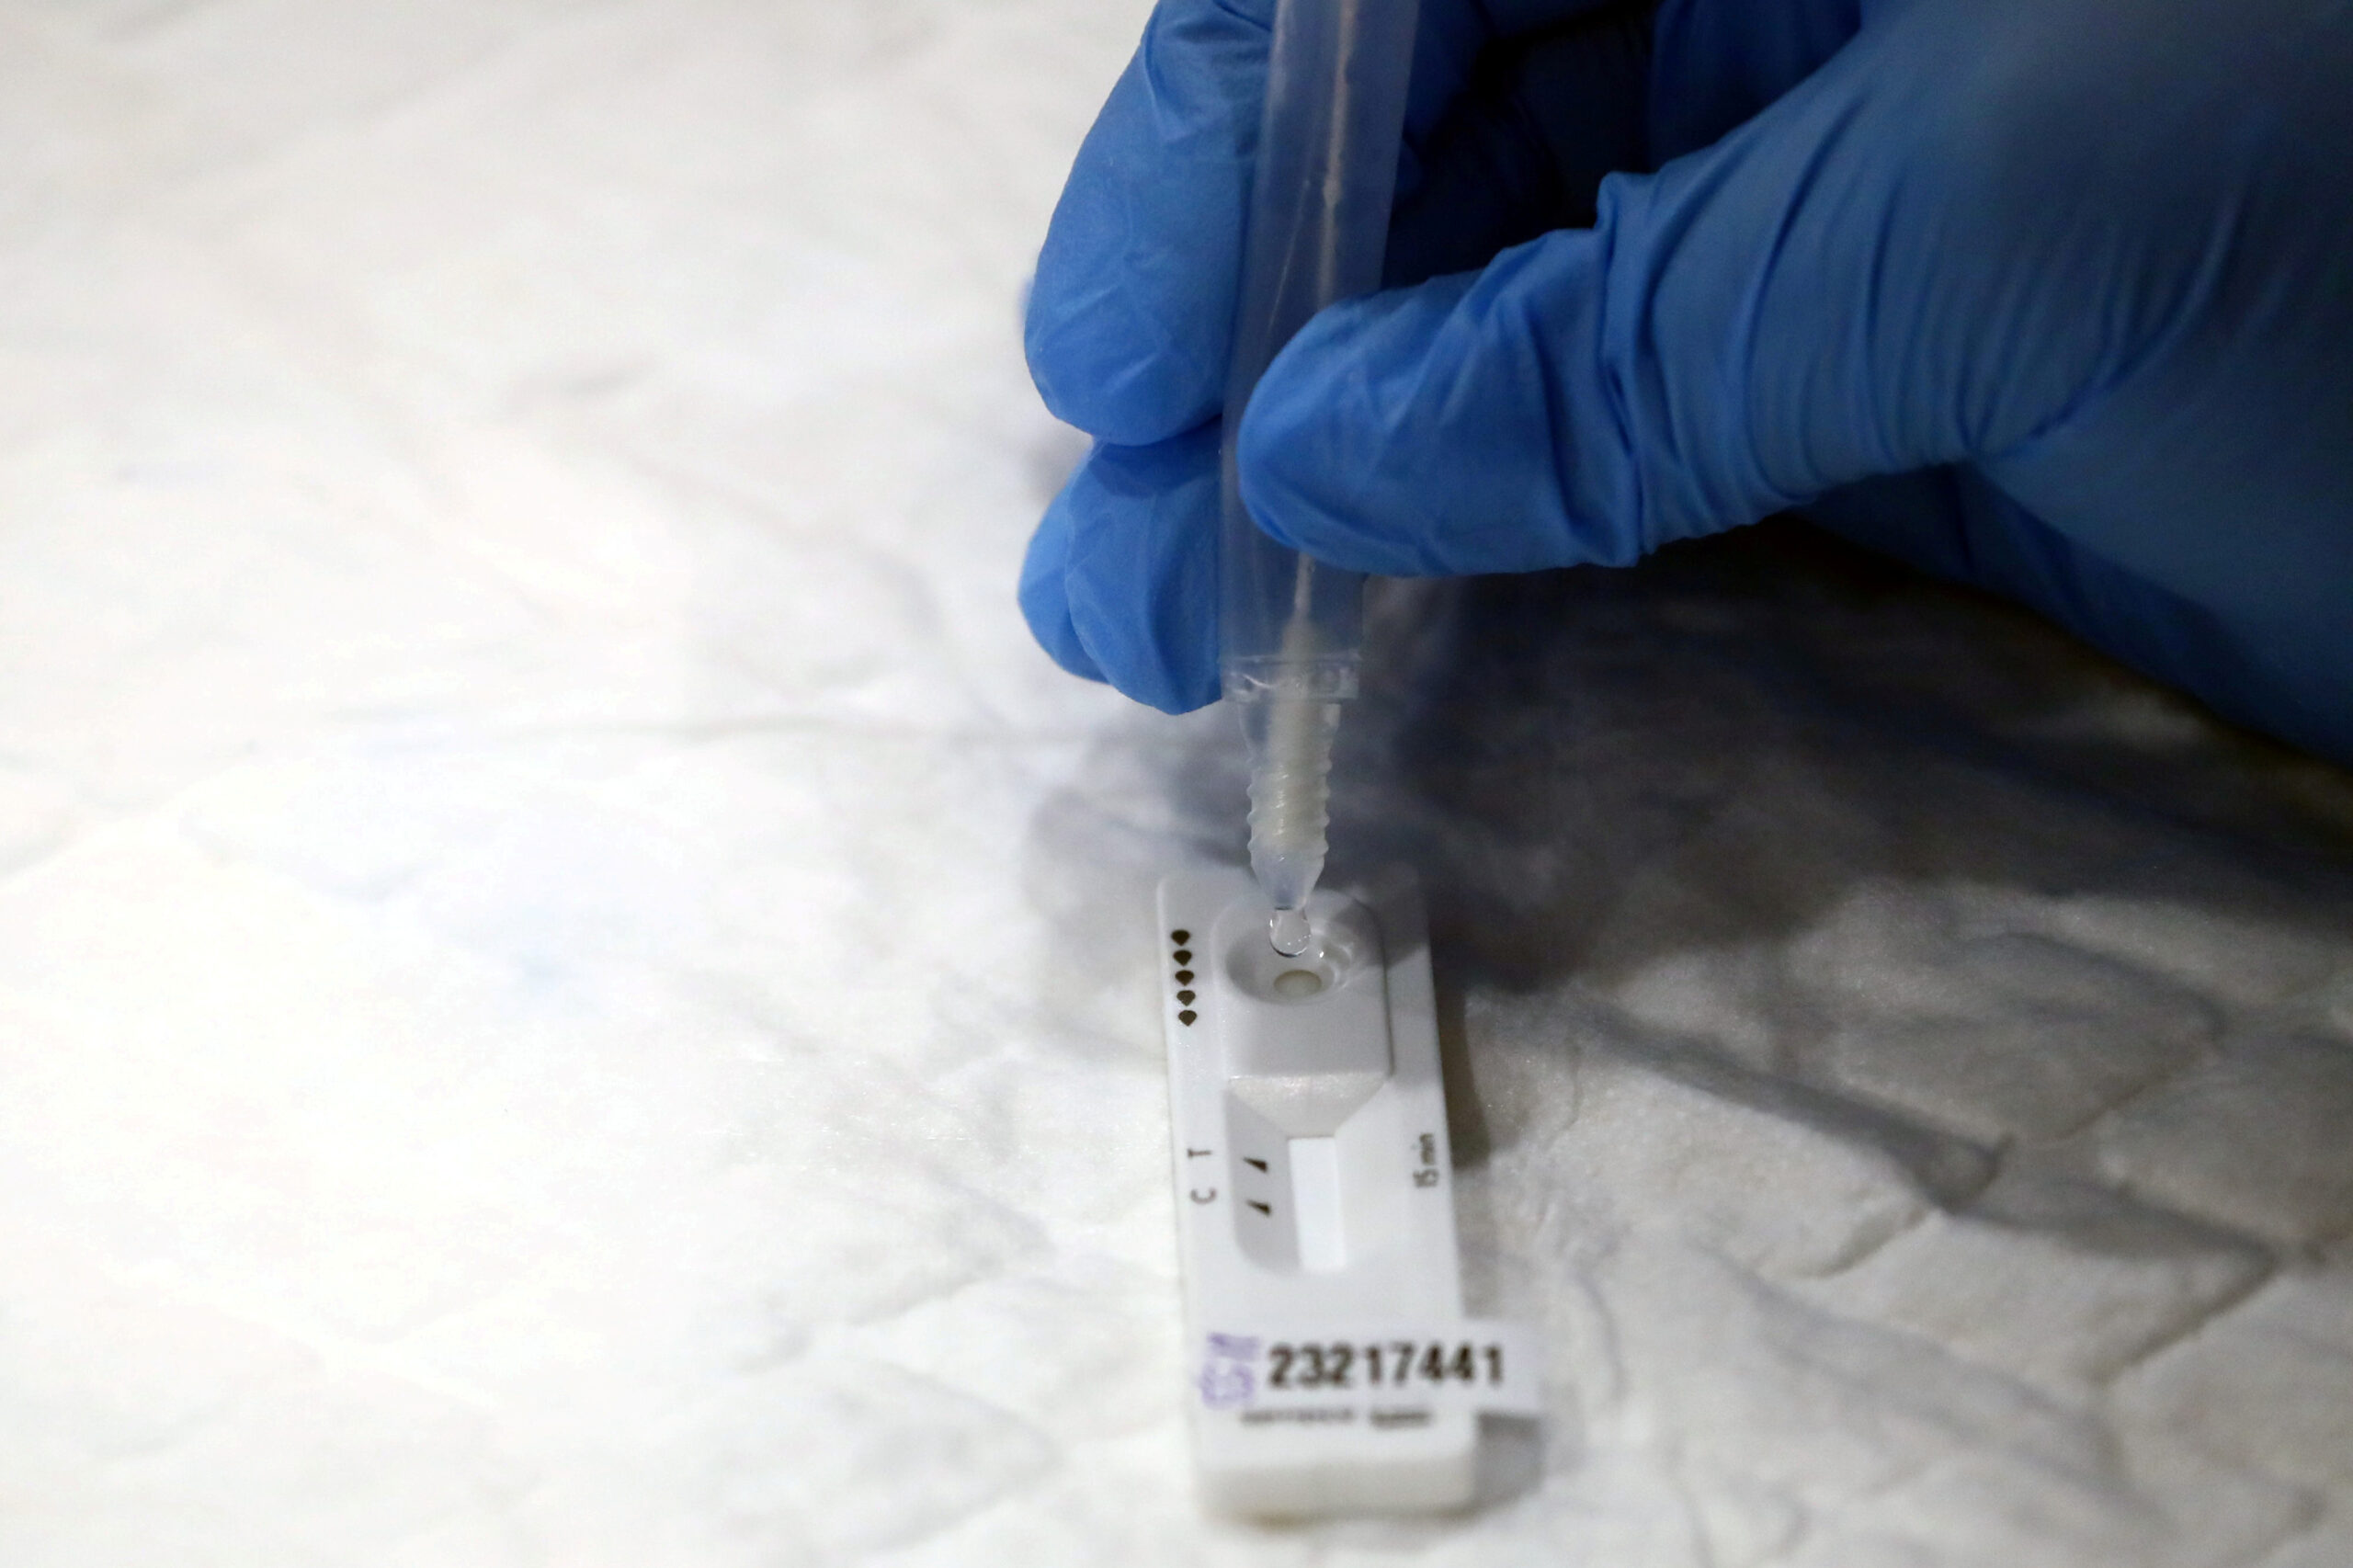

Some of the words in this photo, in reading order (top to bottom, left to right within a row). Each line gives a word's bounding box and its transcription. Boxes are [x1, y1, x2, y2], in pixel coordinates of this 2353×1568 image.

[1188, 1148, 1212, 1158] T
[1190, 1187, 1217, 1204] C
[1268, 1343, 1503, 1388] 23217441
